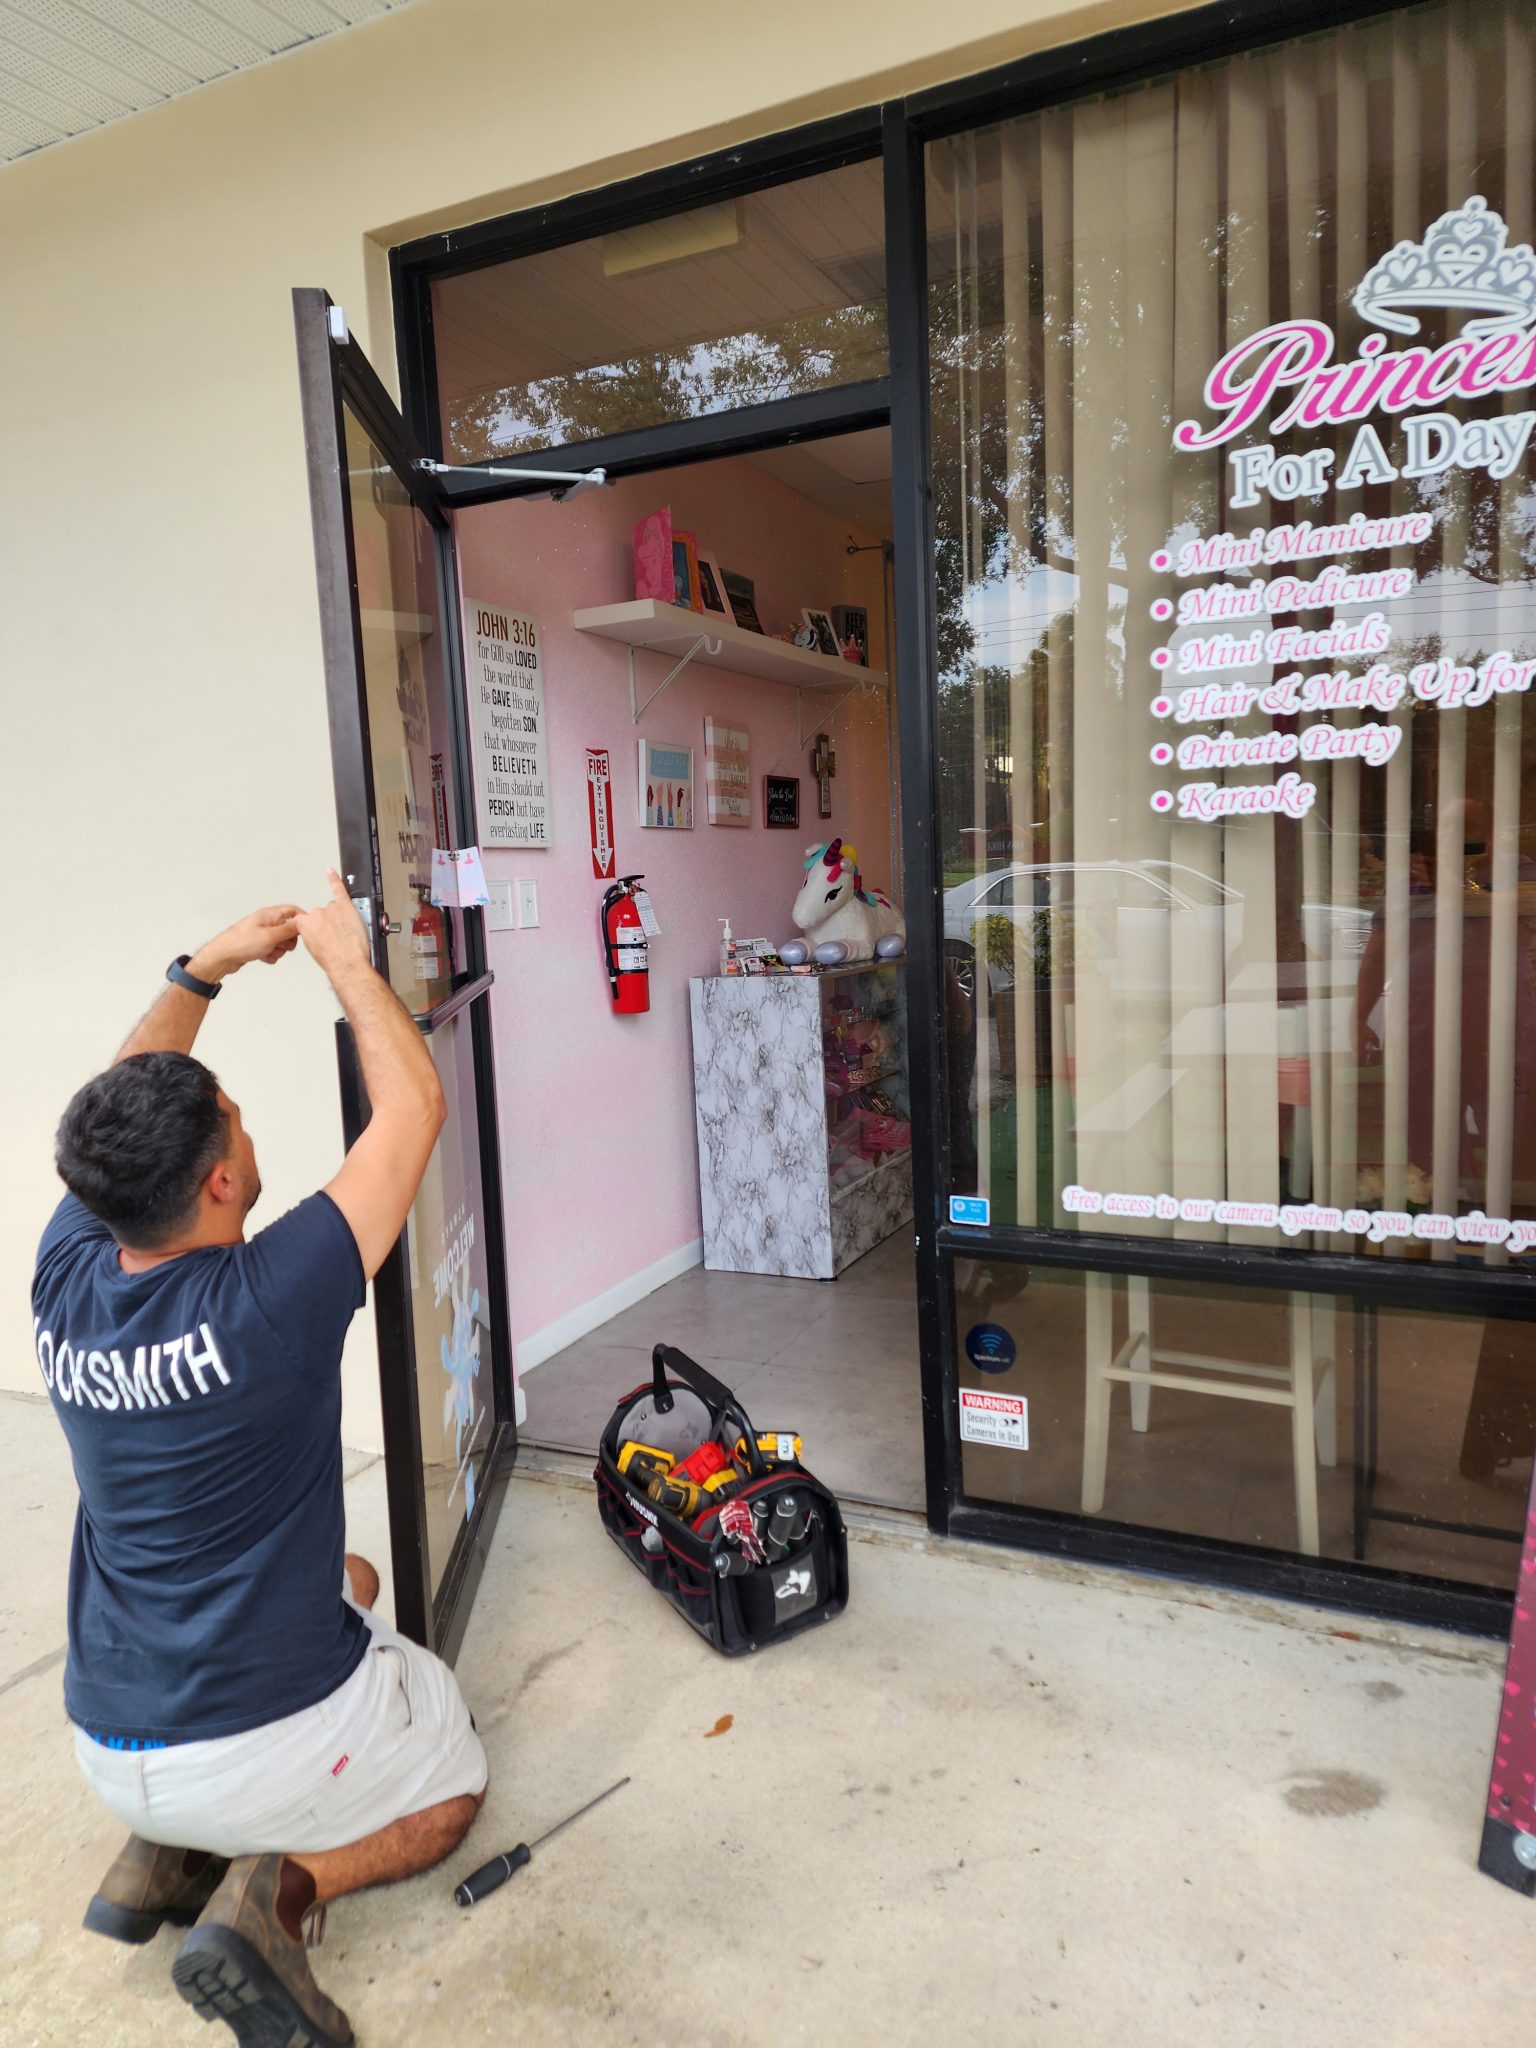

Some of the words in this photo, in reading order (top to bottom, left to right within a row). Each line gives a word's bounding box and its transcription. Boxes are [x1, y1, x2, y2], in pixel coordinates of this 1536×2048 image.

[1234, 448, 1333, 506] For
[1338, 427, 1397, 487] A
[1403, 414, 1534, 478] Day
[1179, 531, 1263, 575] Mini
[1265, 514, 1431, 562] Manicure
[1180, 582, 1262, 623] Mini
[1266, 567, 1411, 611] Pedicure
[476, 609, 509, 642] JOHN
[512, 618, 536, 648] 3:16
[1180, 634, 1261, 672] Mini
[1268, 615, 1389, 662] Facials
[478, 640, 490, 660] for
[490, 643, 504, 663] GOD
[505, 651, 514, 665] so
[514, 648, 537, 670] LOVED
[483, 663, 495, 684] the
[497, 669, 518, 688] world
[519, 671, 534, 691] that
[1178, 682, 1256, 722] Hair
[1261, 675, 1302, 712] &
[1302, 666, 1404, 709] Make
[1412, 659, 1473, 705] Up
[480, 685, 491, 705] He
[491, 688, 511, 708] GAVE
[512, 692, 524, 711] His
[524, 696, 540, 717] only
[491, 710, 522, 733] begotten
[484, 731, 500, 750] that
[501, 734, 537, 755] whosoever
[1180, 733, 1296, 767] Private
[1303, 726, 1399, 766] Party
[492, 755, 537, 776] BELIEVETH
[587, 758, 608, 776] FIRE
[487, 778, 495, 794] in
[495, 777, 510, 795] Him
[511, 778, 533, 797] should
[533, 780, 545, 798] not
[1179, 775, 1313, 817] Karaoke
[488, 799, 515, 817] PERISH
[516, 800, 529, 818] but
[529, 800, 545, 818] have
[596, 776, 607, 870] EXTINGUISHER
[490, 821, 529, 842] everlasting
[1066, 1187, 1100, 1210] Free
[1105, 1195, 1154, 1216] access
[1158, 1197, 1178, 1216] to
[1182, 1200, 1214, 1221] our
[1217, 1203, 1275, 1223] camera
[1281, 1205, 1340, 1233] system
[1346, 1211, 1368, 1231] so
[1371, 1213, 1409, 1239] you
[1416, 1216, 1451, 1237] can
[1459, 1214, 1508, 1240] view
[34, 1316, 232, 1411] OCKSMITH
[964, 1394, 1022, 1413] WARNING
[966, 1411, 997, 1428] Security
[966, 1425, 996, 1440] Cameras
